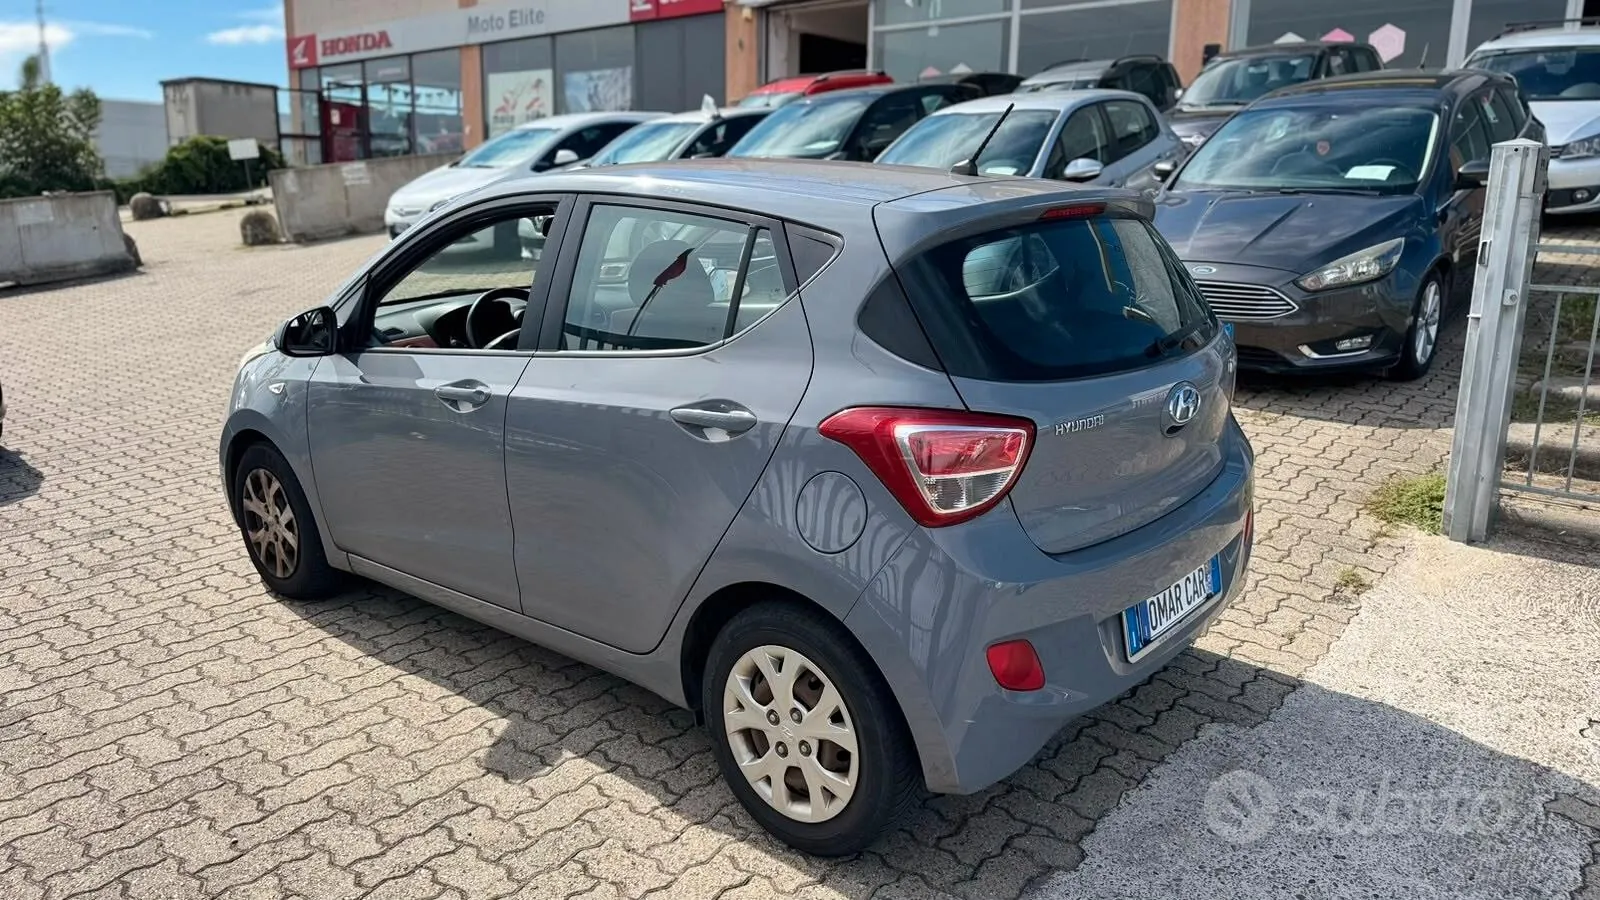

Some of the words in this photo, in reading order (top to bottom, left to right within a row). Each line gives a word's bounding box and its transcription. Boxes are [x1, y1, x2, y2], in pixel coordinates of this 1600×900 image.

[467, 14, 505, 34] Moto
[508, 8, 545, 29] Elite
[321, 30, 393, 57] HONDA
[1055, 414, 1104, 436] HYUNDAI
[1148, 582, 1184, 631] OMAR
[1184, 567, 1206, 606] CAR
